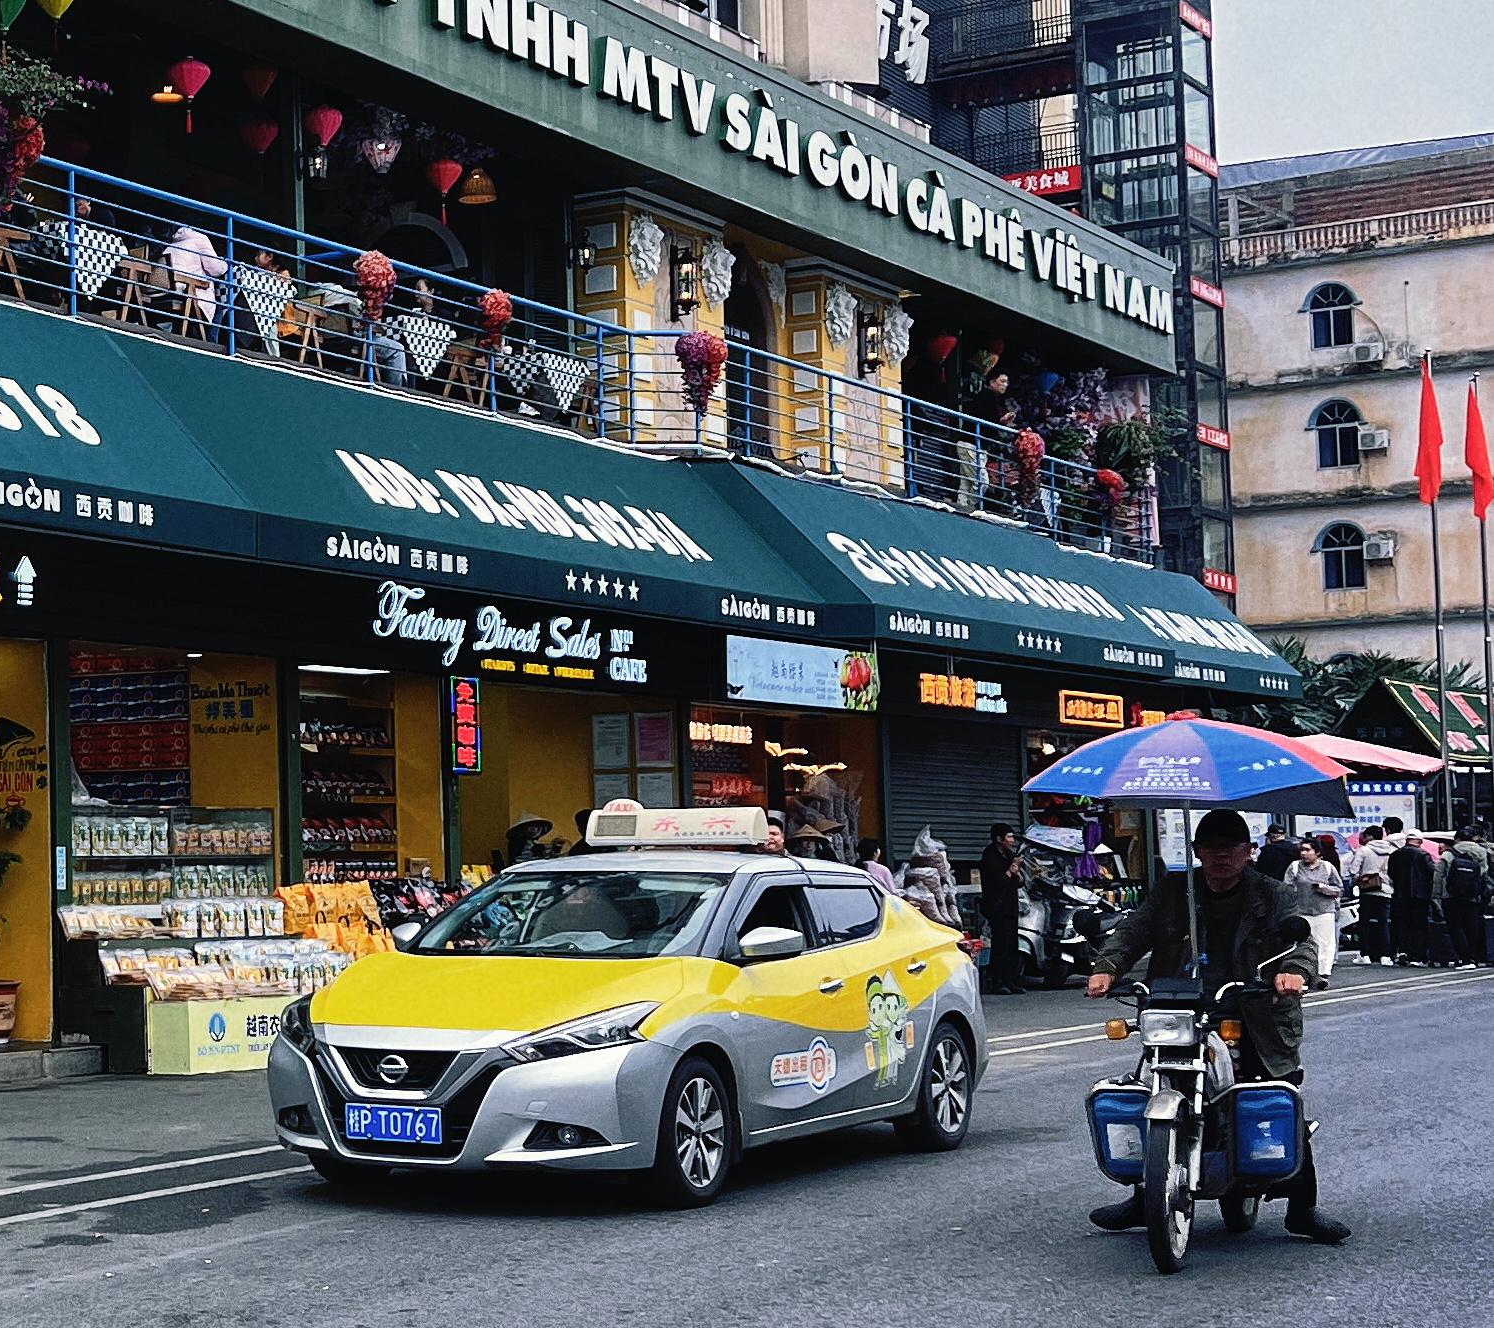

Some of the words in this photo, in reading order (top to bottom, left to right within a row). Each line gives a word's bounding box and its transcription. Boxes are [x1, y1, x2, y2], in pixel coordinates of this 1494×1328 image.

[599, 33, 715, 136] MTV
[722, 88, 799, 176] SÀI
[807, 129, 899, 217] GÒN
[906, 170, 955, 241] CÀ
[960, 207, 1026, 271] PHÊ
[1103, 263, 1174, 335] NAM
[335, 448, 460, 519] ADD:
[75, 493, 155, 528] 西贡咖啡
[326, 531, 401, 564] SÀIGÒN
[409, 547, 469, 576] 西贡咖啡
[372, 579, 466, 667] Factory
[473, 605, 541, 653] Direct
[545, 616, 601, 660] Sales
[721, 593, 770, 621] SÀIGÒN
[889, 611, 931, 635] SÀIGÒN
[610, 657, 648, 683] CAFE
